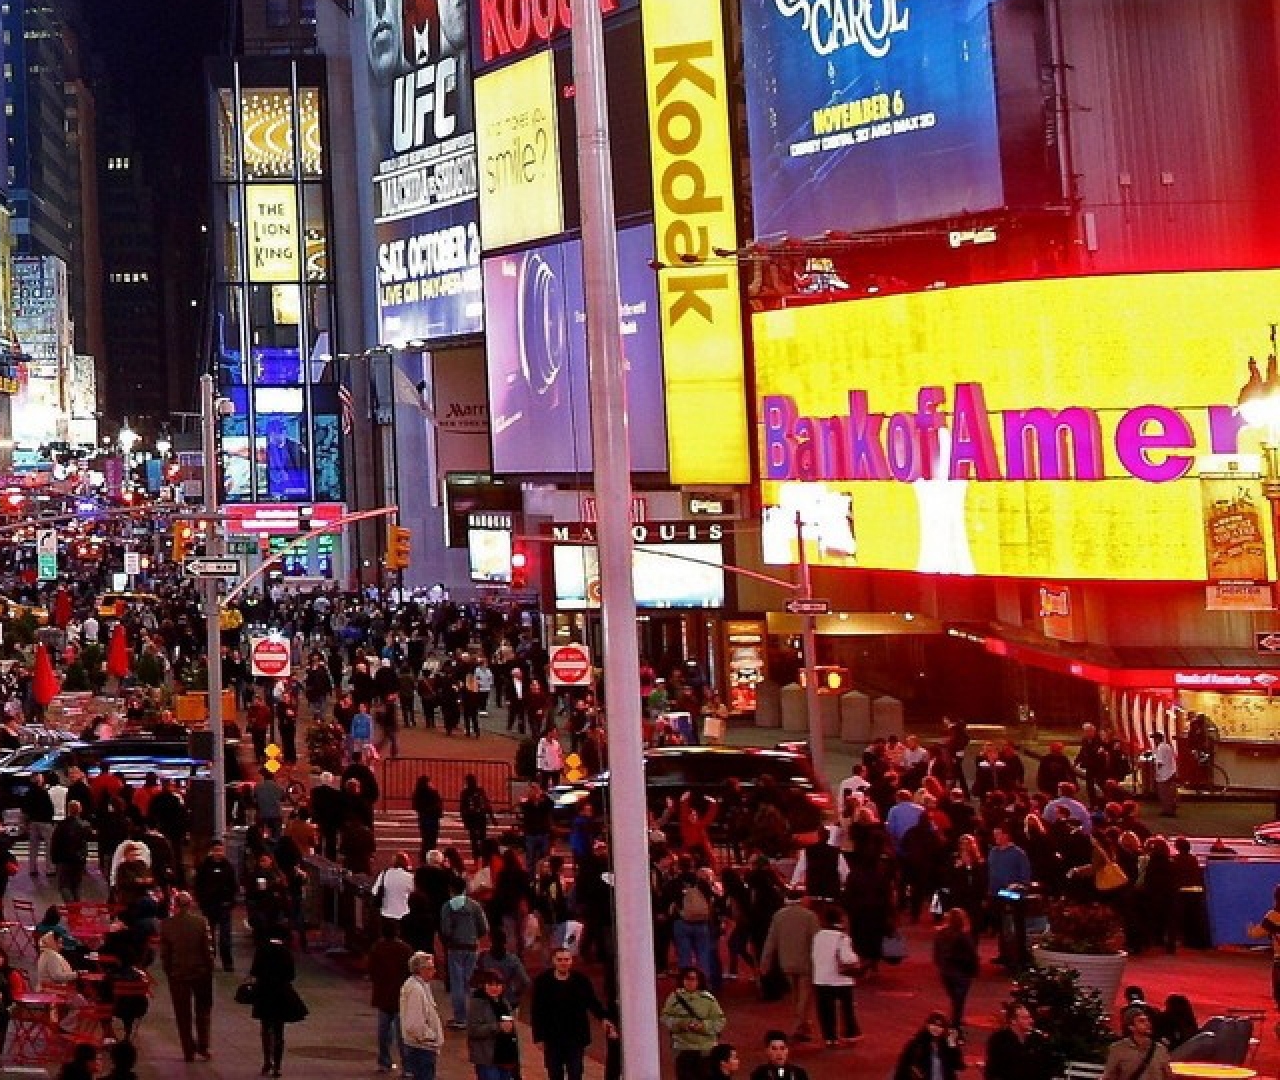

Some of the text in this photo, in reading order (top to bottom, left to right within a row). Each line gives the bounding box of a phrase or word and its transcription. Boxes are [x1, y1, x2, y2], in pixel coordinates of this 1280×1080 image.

[392, 55, 457, 154] UFC
[812, 89, 905, 136] NOVEMBER 6
[653, 39, 732, 325] Kodak
[253, 220, 291, 243] LION
[257, 202, 284, 217] THE
[254, 245, 294, 269] KING
[407, 226, 467, 278] OCTOBER
